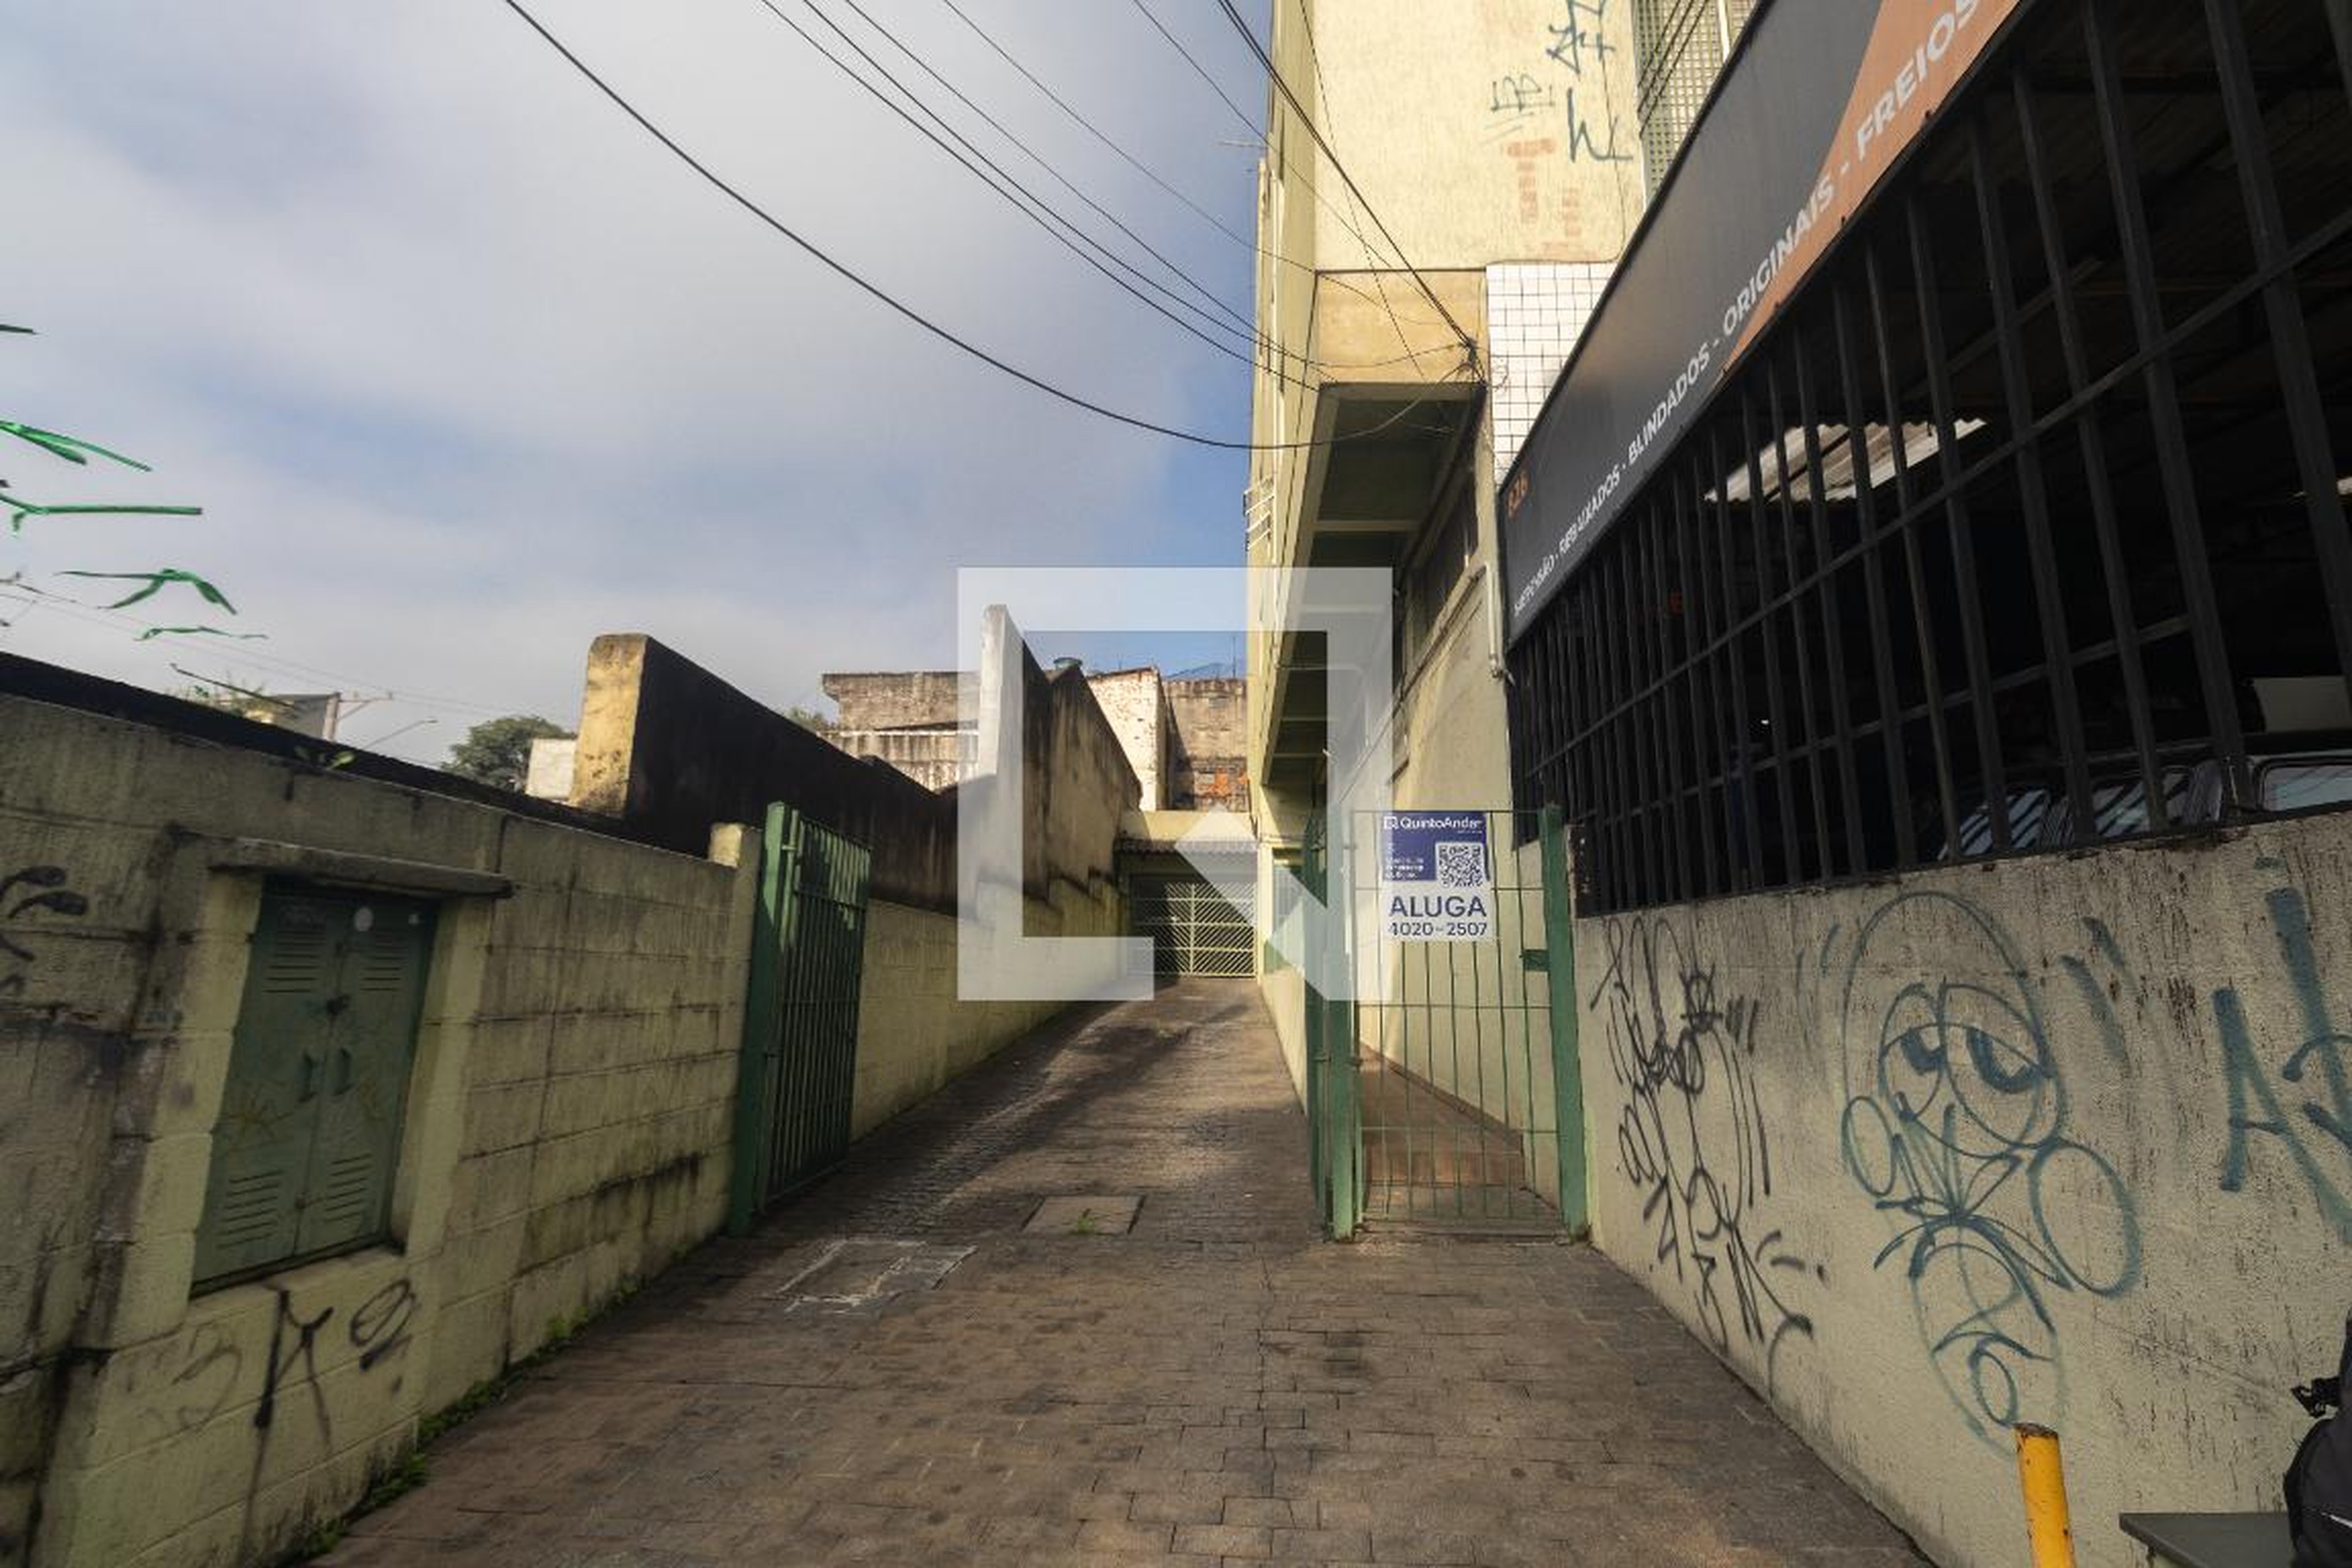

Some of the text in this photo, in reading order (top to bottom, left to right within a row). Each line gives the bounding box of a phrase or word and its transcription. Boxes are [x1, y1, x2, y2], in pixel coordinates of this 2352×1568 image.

[1629, 342, 1709, 465] BLINDADOS
[1724, 175, 1833, 335] ORIGINAIS
[1400, 816, 1482, 828] QuintoAndar
[1389, 895, 1488, 918] ALUGA
[1389, 922, 1488, 936] 4020-2507
